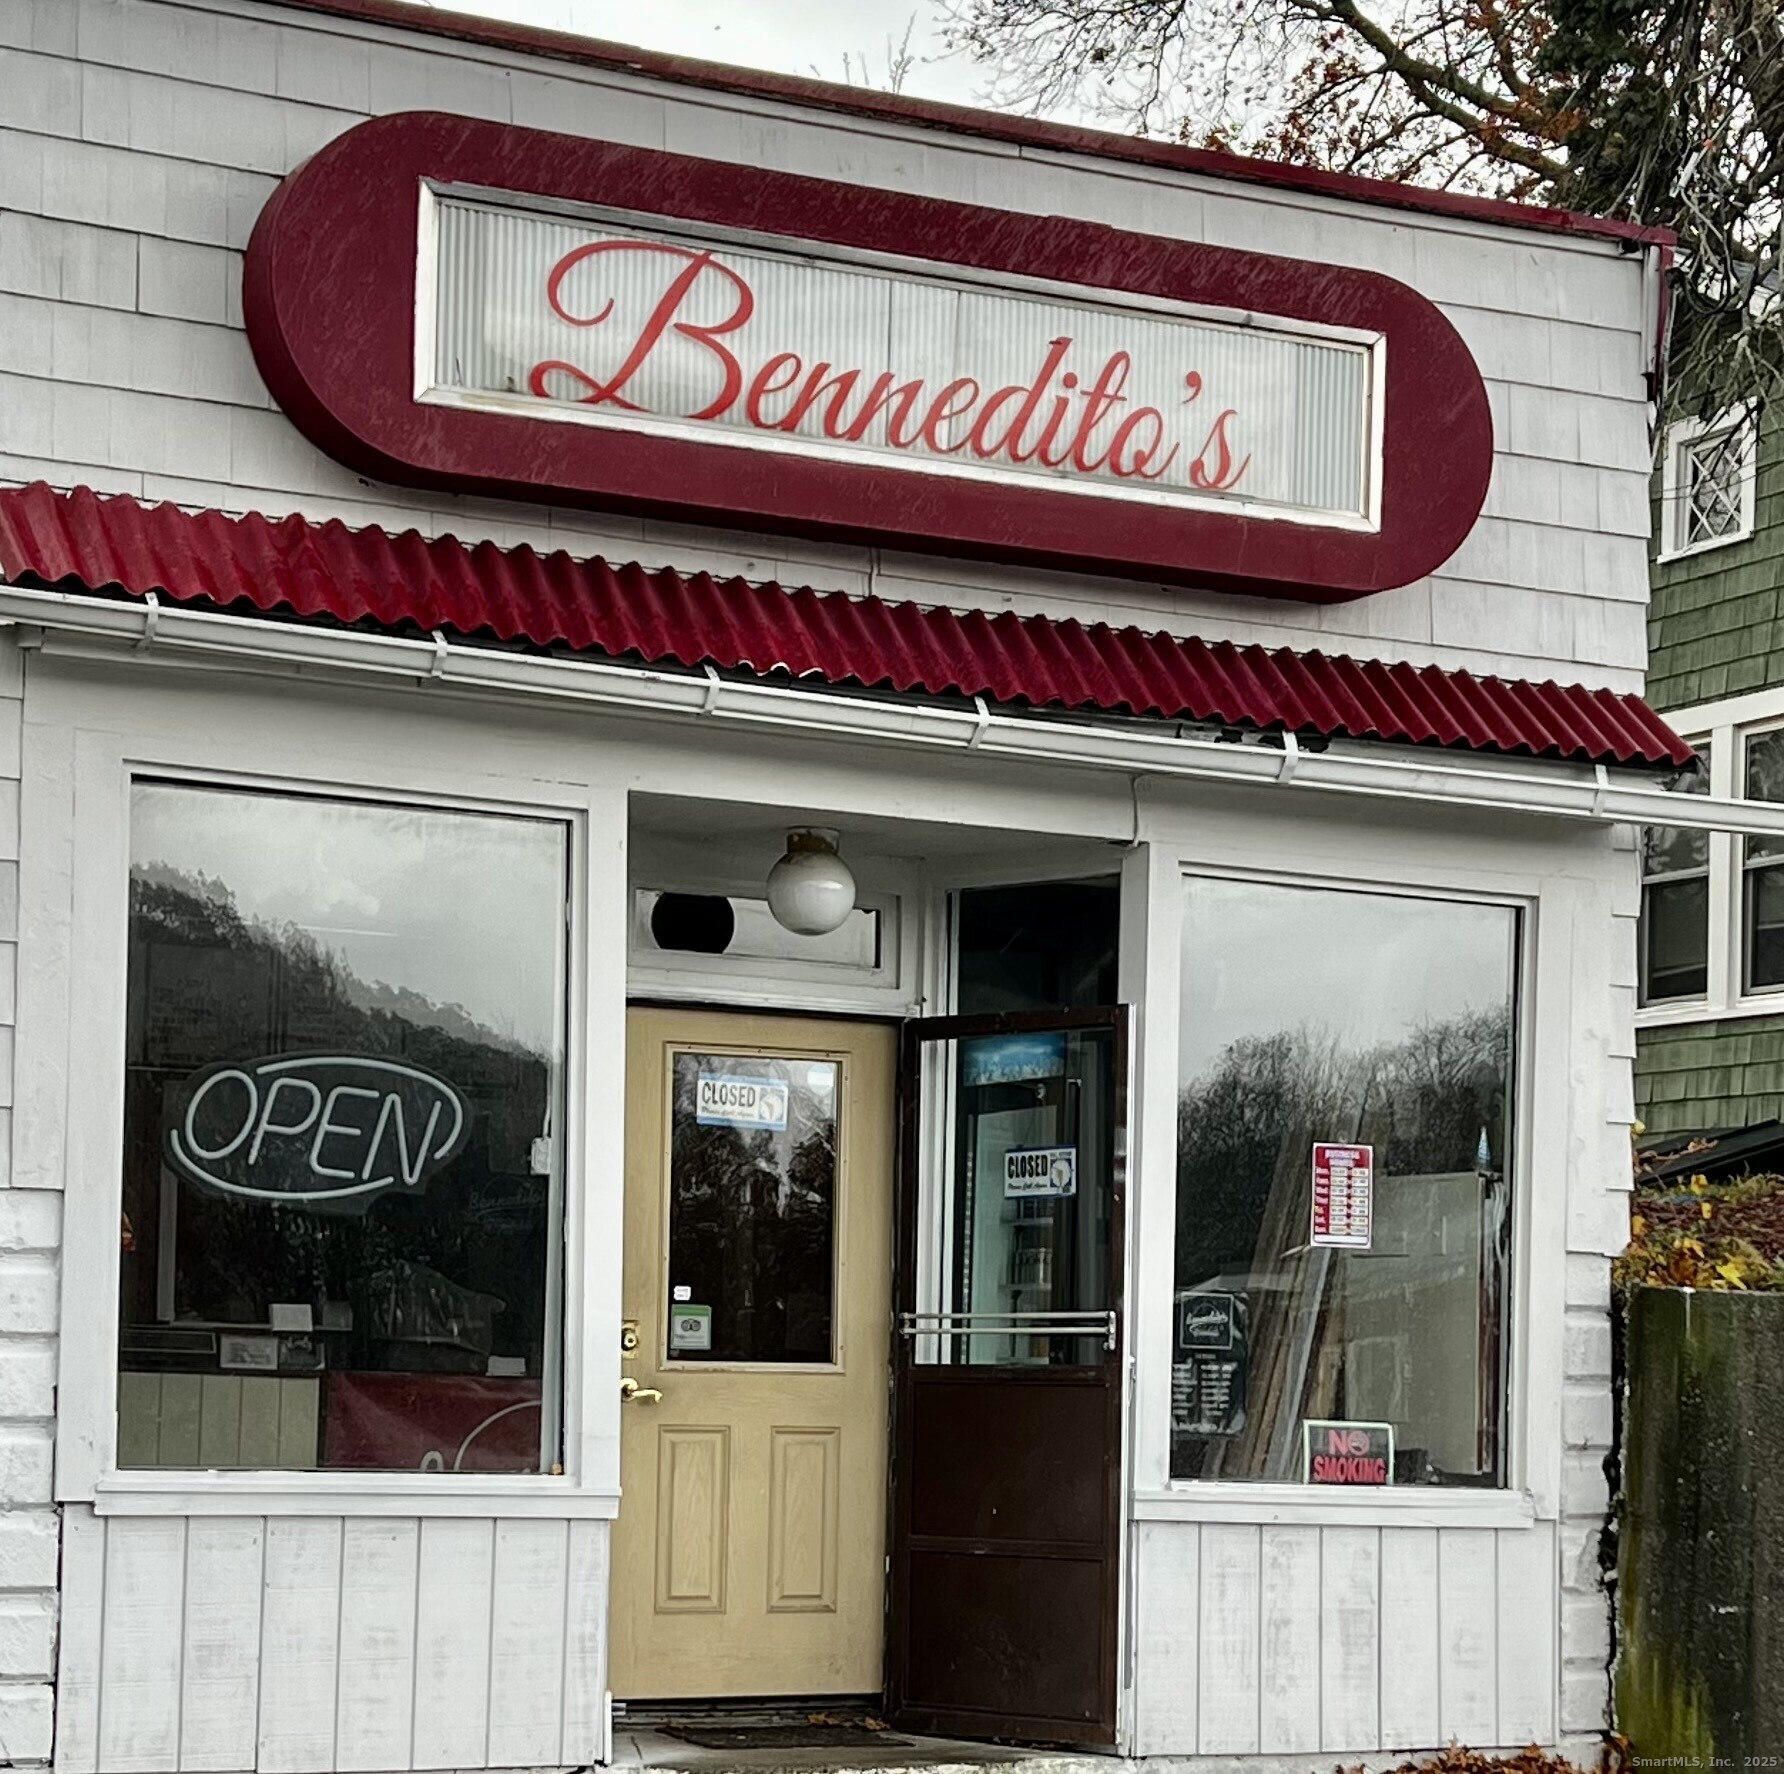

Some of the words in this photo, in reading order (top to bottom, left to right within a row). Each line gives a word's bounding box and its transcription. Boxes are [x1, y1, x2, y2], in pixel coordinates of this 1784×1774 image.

[530, 240, 1252, 491] Bennedito's
[702, 1081, 756, 1107] CLOSED
[185, 1069, 443, 1186] OPEN
[1008, 1154, 1048, 1179] CLOSED
[1328, 1429, 1371, 1457] NO
[1313, 1455, 1386, 1484] SMOKING
